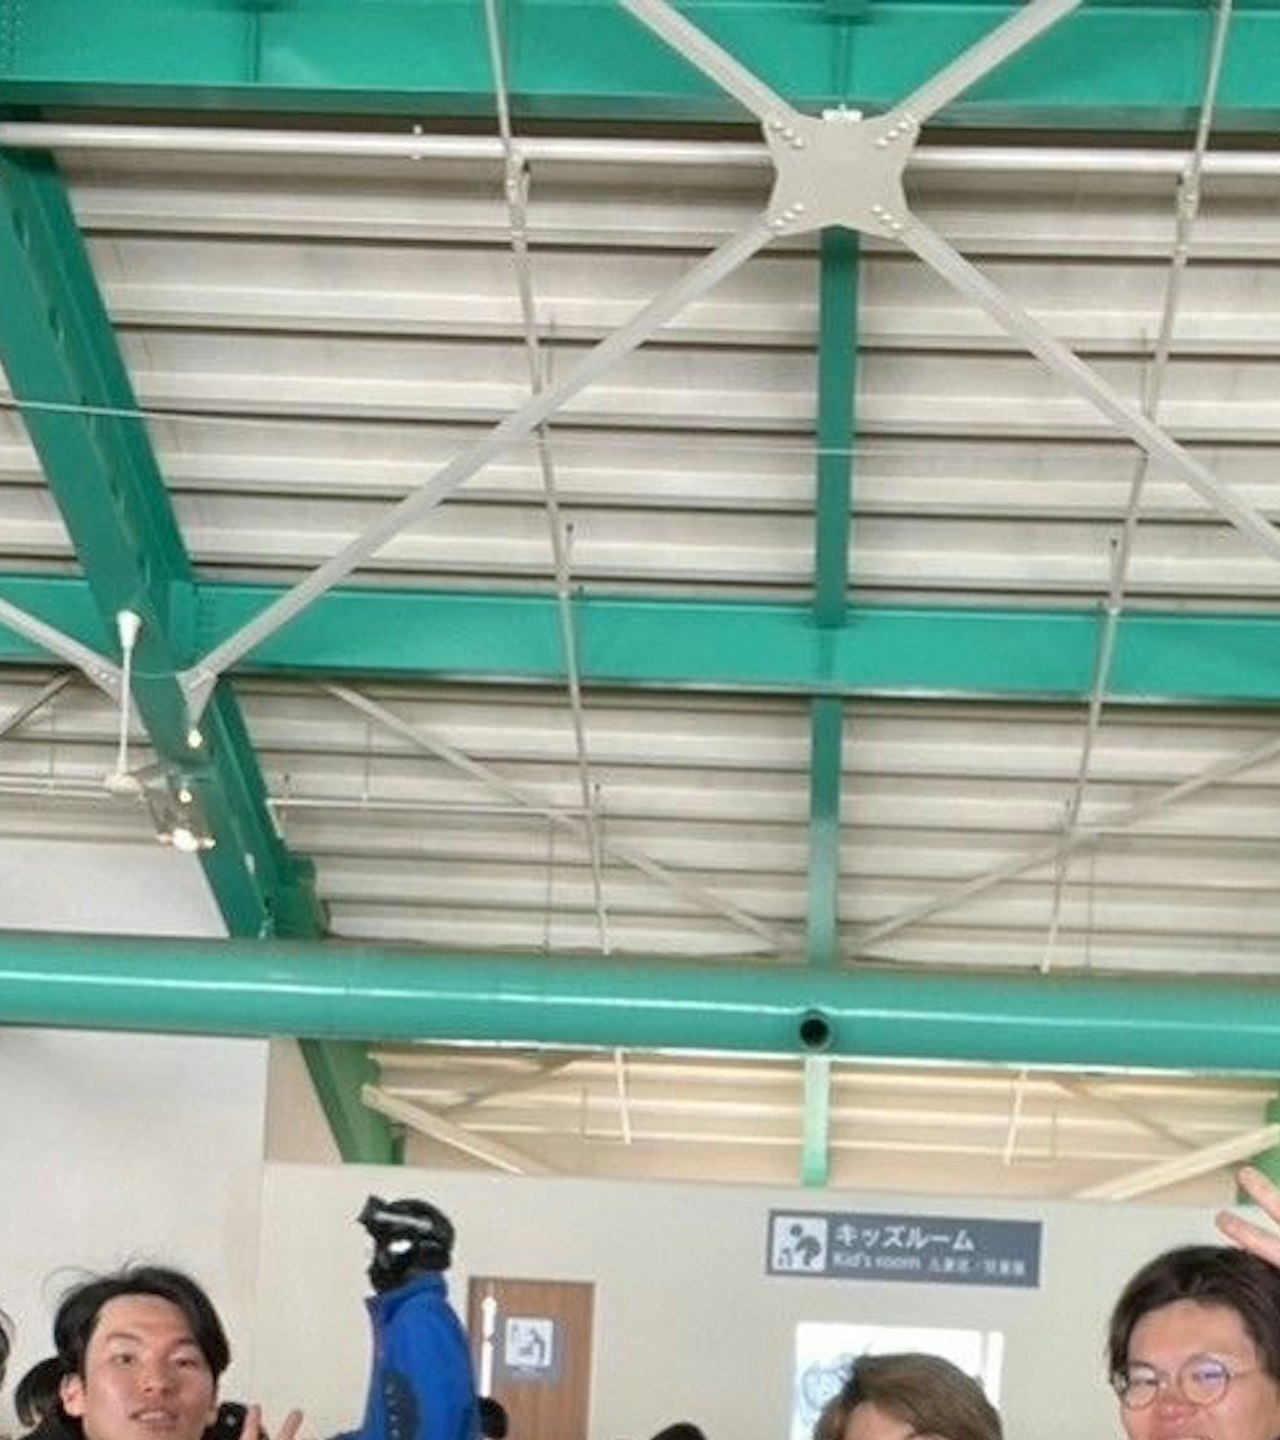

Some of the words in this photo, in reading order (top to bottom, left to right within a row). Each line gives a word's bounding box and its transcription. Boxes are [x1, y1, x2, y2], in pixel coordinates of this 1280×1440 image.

[835, 1223, 974, 1251] キッズルーム
[833, 1252, 871, 1267] Kid's
[875, 1256, 920, 1271] room
